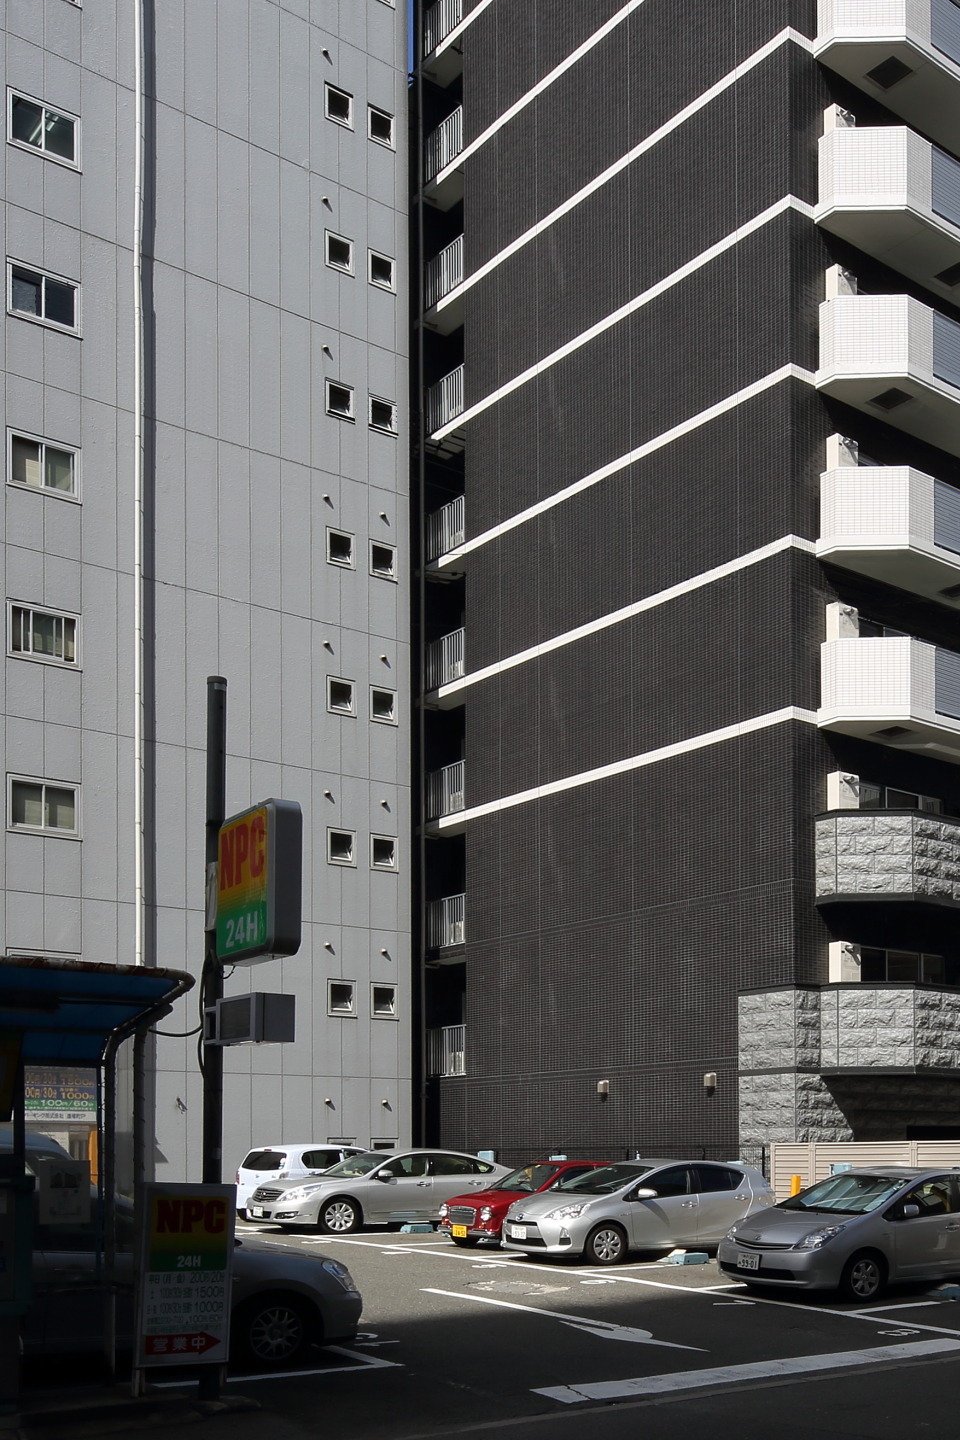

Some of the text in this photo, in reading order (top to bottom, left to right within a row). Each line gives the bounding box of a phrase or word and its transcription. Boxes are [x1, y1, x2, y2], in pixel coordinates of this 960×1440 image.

[220, 816, 265, 892] NPC
[225, 911, 259, 949] 24H
[156, 1199, 226, 1234] NPC
[176, 1255, 202, 1269] 24H
[152, 1335, 206, 1353] 営業中
